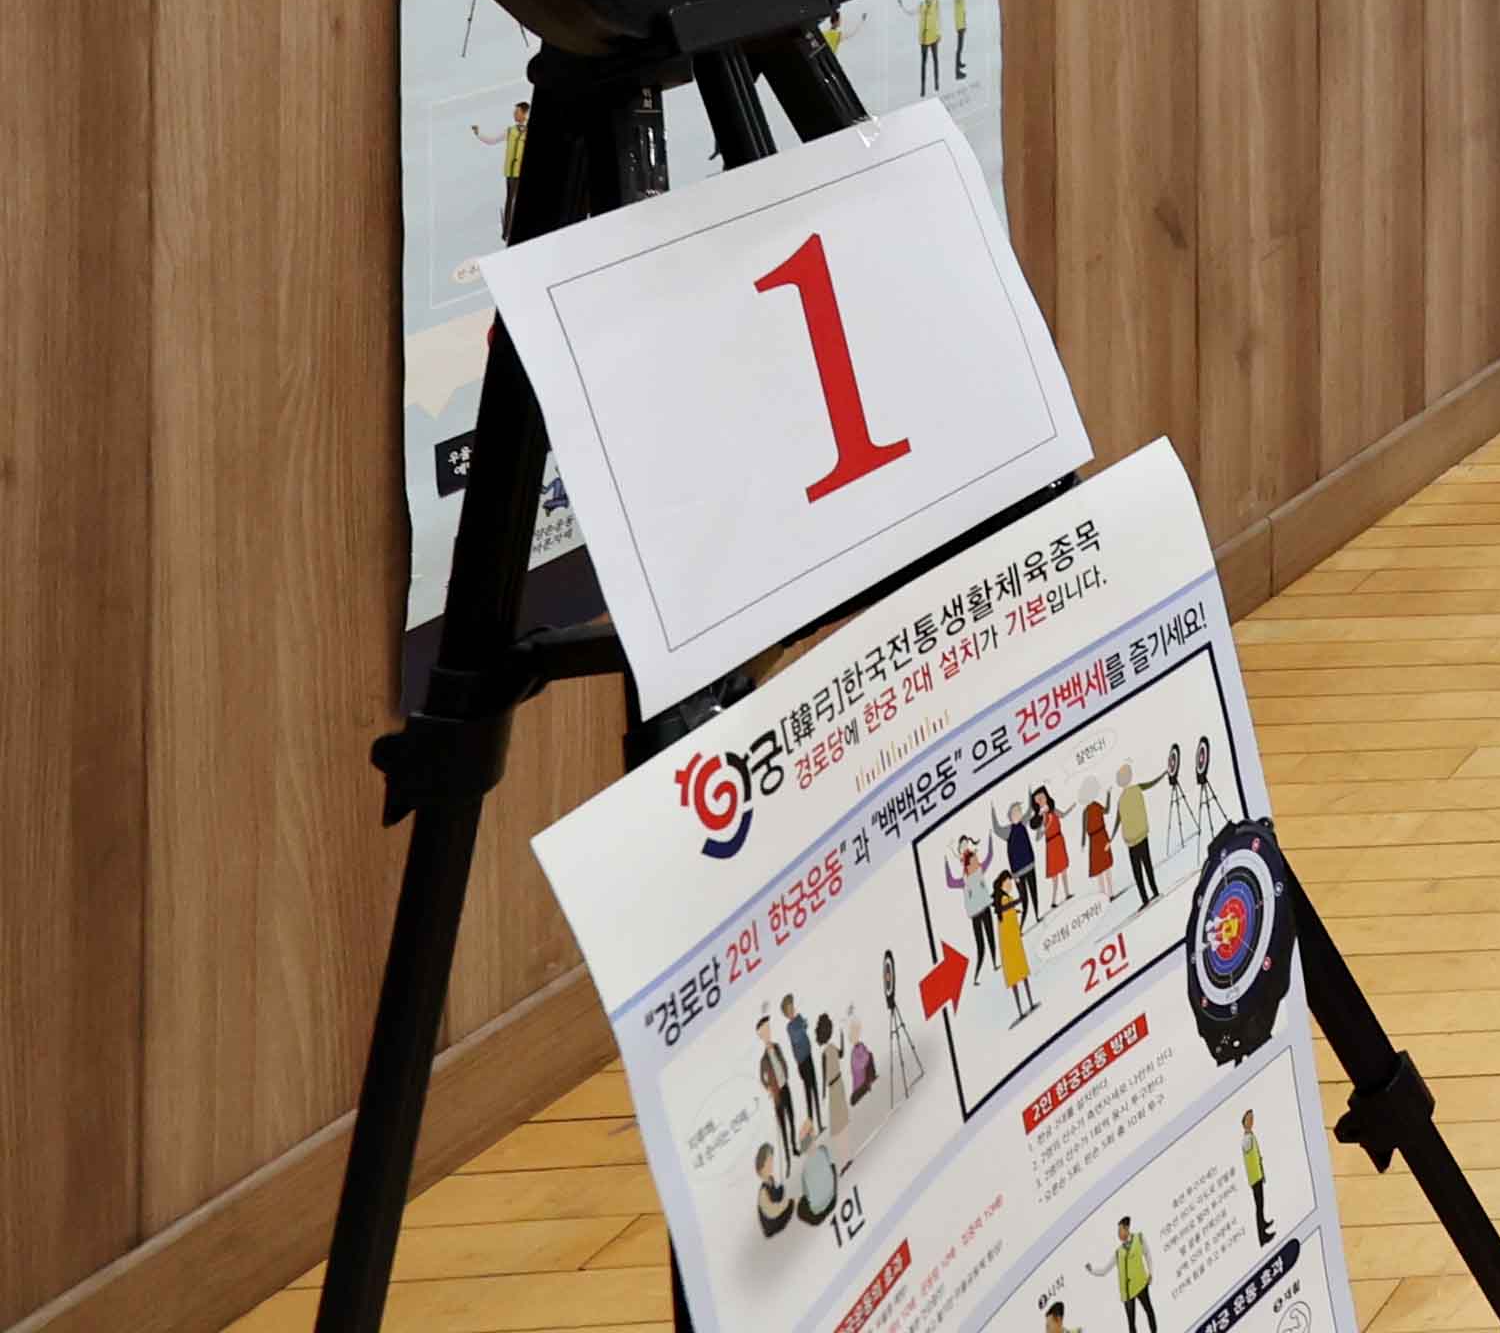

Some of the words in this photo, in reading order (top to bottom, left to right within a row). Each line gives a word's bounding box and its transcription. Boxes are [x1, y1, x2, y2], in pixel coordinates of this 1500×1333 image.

[753, 231, 912, 504] 1
[792, 719, 860, 790] 경로당에
[862, 687, 898, 734] 한궁
[903, 661, 934, 704] 2대
[937, 624, 999, 681] 설치가
[1004, 564, 1108, 636] 기본입니다.
[724, 919, 762, 984] 2인
[851, 828, 871, 866] 과
[970, 726, 1012, 774] 으로
[1014, 653, 1126, 746] 건강백세를
[1129, 601, 1208, 674] 즐기세요!
[1079, 932, 1130, 994] 2인
[1031, 1091, 1053, 1121] 2인
[1055, 1046, 1109, 1102] 한궁운동
[1109, 1021, 1139, 1056] 방법
[830, 1185, 866, 1248] 1인
